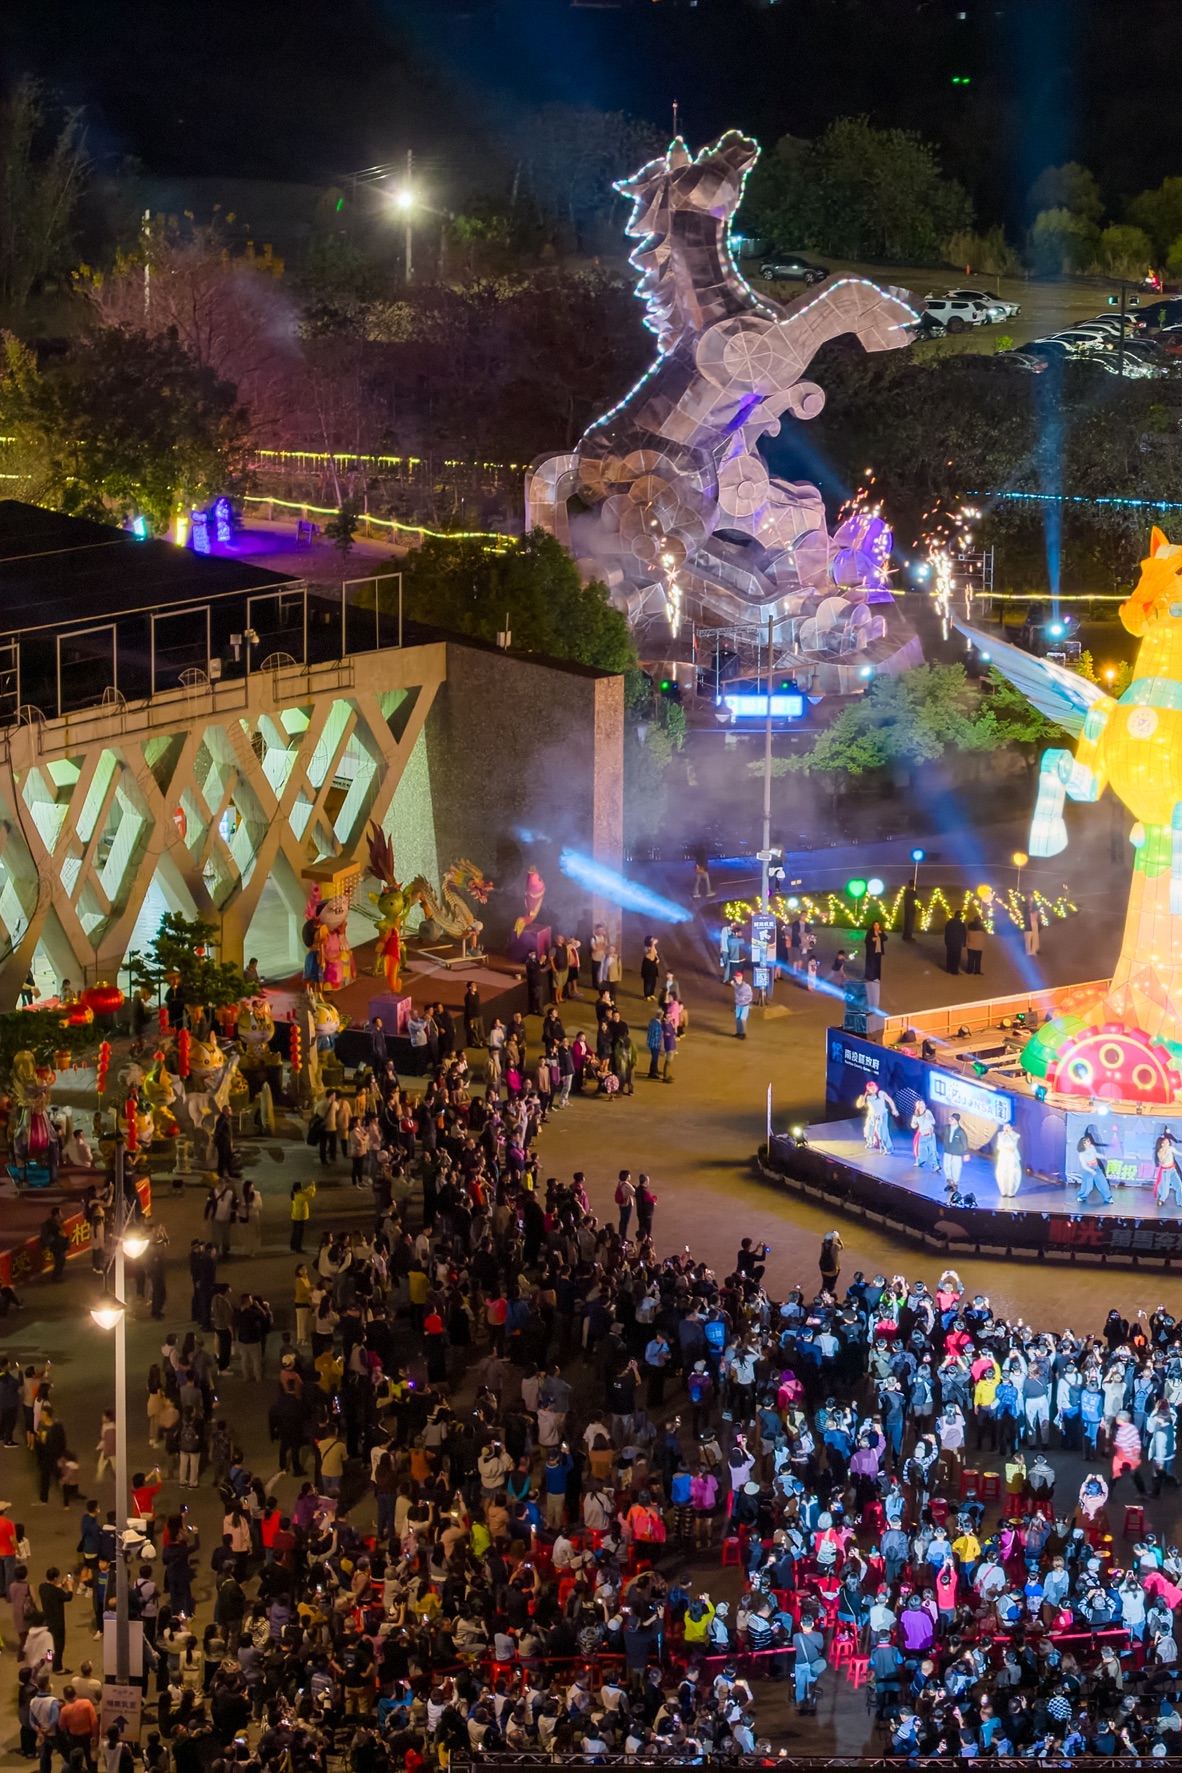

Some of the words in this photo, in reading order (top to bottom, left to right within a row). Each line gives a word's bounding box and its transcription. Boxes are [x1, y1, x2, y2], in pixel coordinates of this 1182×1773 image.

[844, 1048, 880, 1070] 南投縣政府
